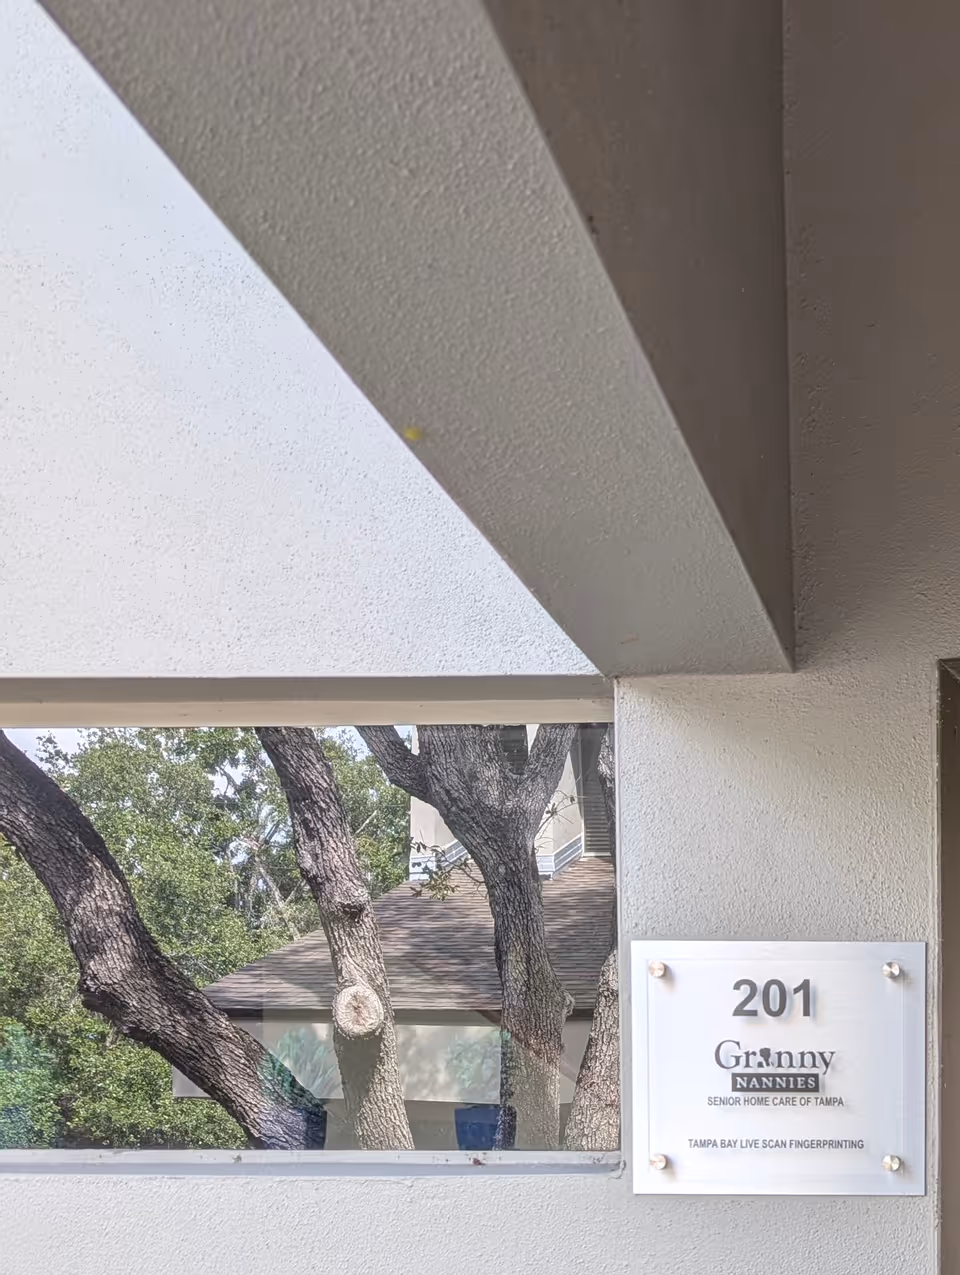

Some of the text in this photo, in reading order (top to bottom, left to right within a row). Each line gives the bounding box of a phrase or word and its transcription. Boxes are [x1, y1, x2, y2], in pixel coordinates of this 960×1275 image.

[733, 979, 812, 1017] 201
[735, 1076, 816, 1089] NANNIES
[707, 1097, 844, 1106] SENIOR HOME CARE OF TAMPA
[688, 1139, 864, 1149] TAMPA BAY LIVE SCAN FINGERPRINTING
